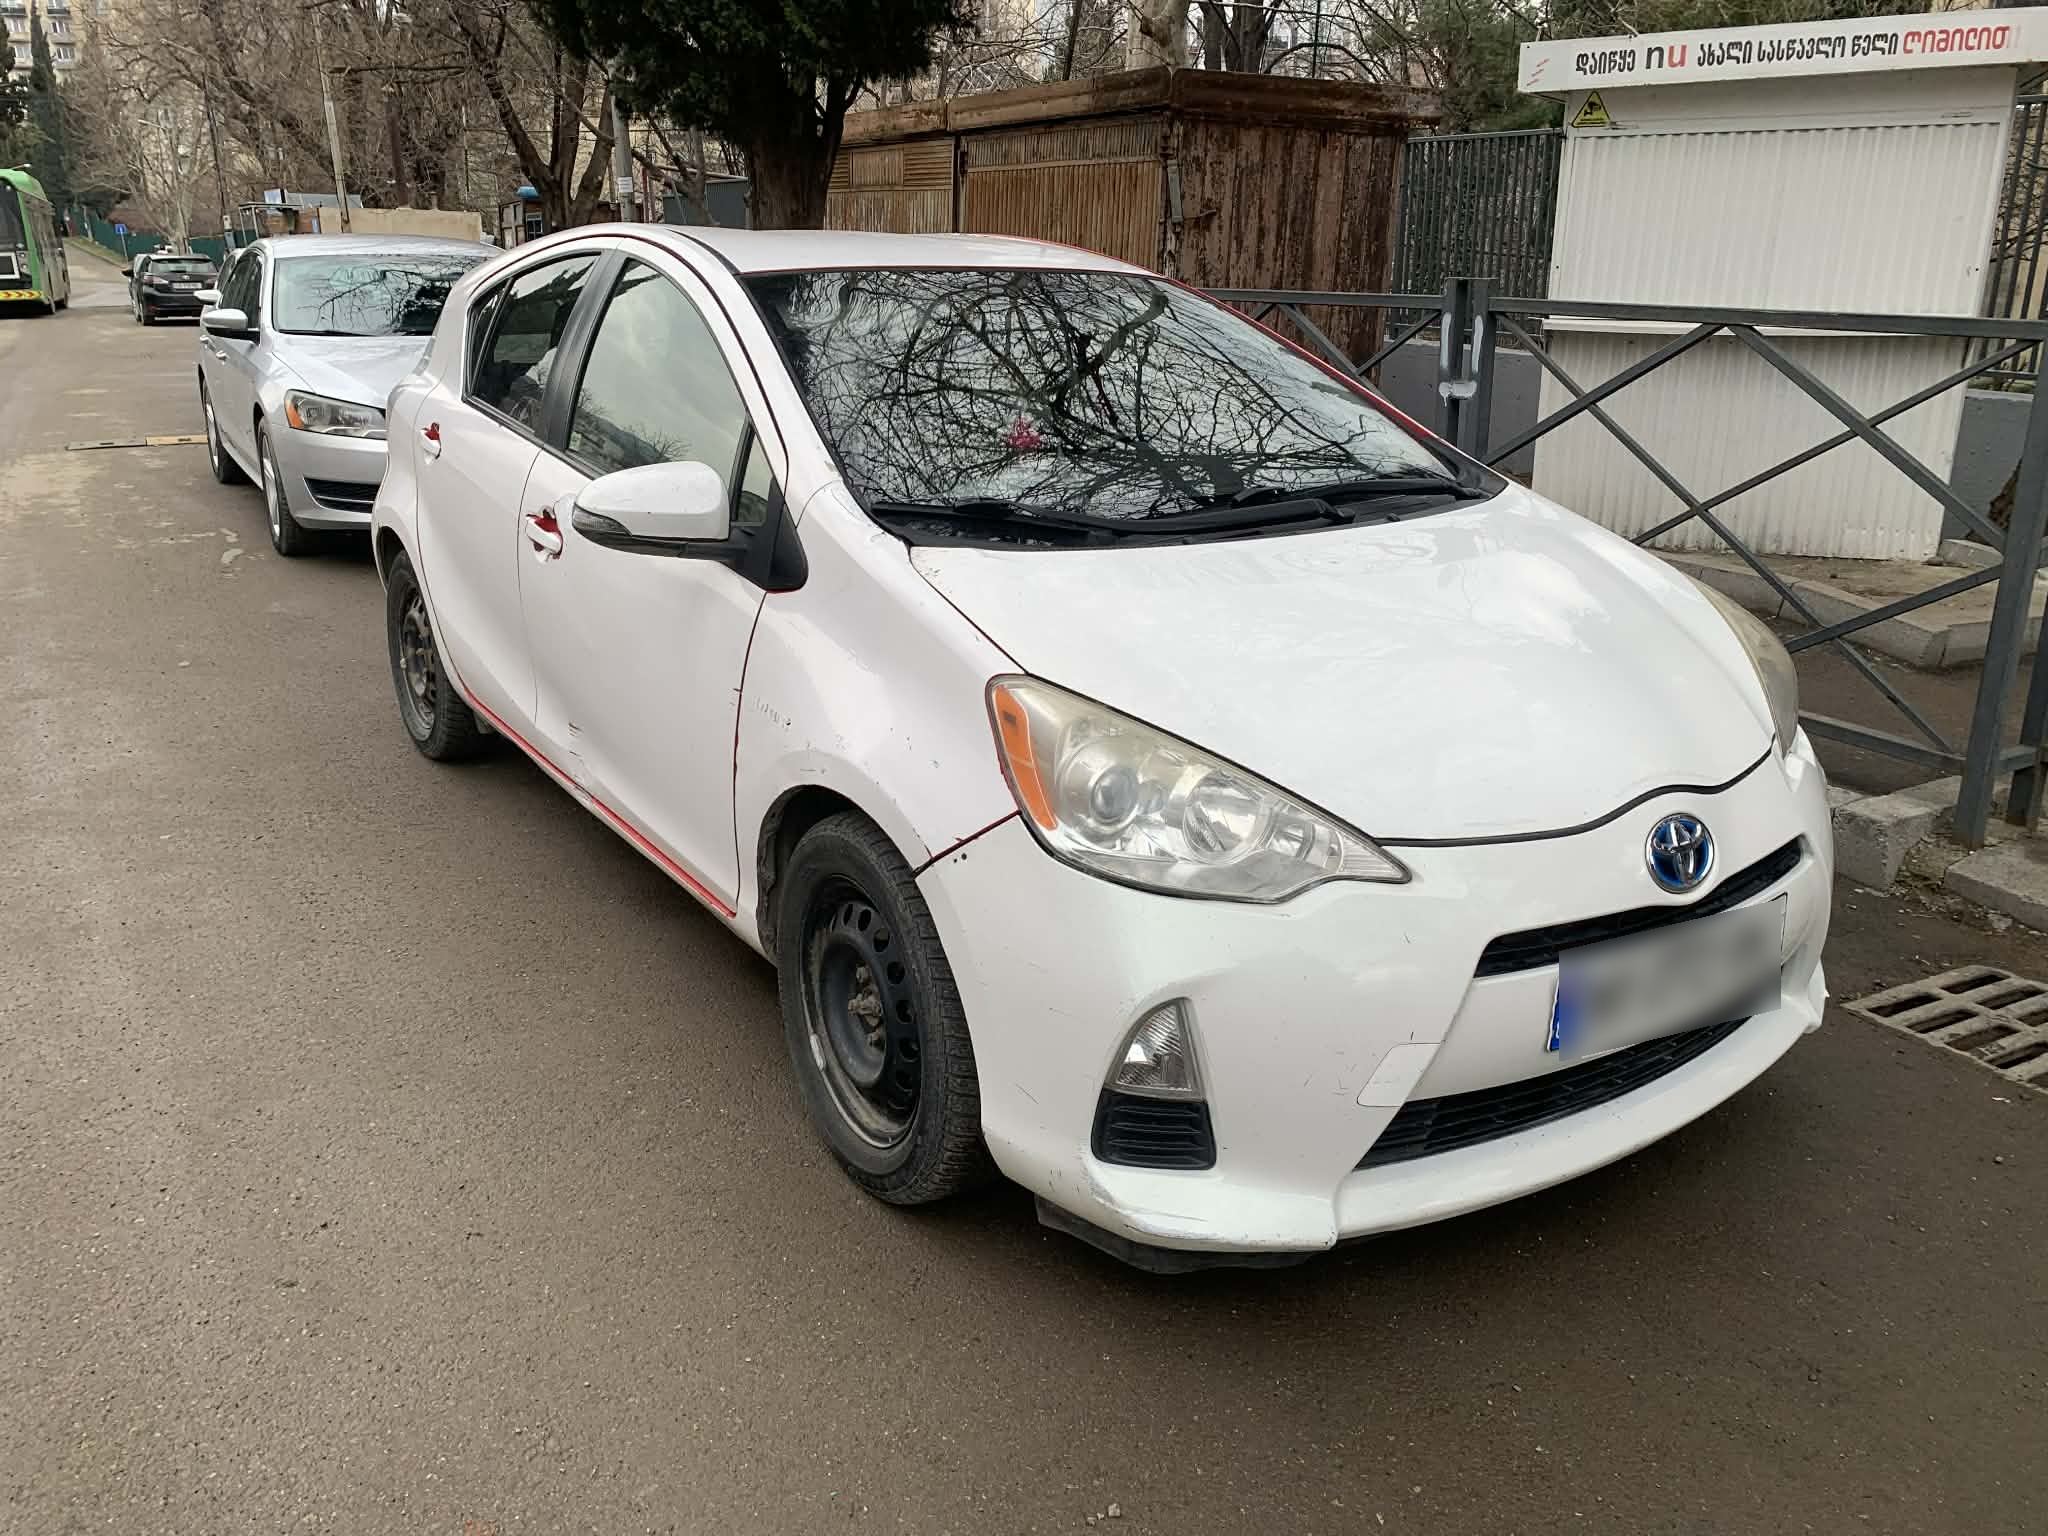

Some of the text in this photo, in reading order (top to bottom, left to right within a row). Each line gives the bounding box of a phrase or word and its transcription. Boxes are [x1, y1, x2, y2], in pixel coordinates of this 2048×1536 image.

[1576, 50, 1636, 75] დაიწყე
[1645, 44, 1688, 69] nu
[1697, 40, 1753, 67] ახალი
[1757, 35, 1847, 63] სასწავლო
[1851, 33, 1899, 57] წელი
